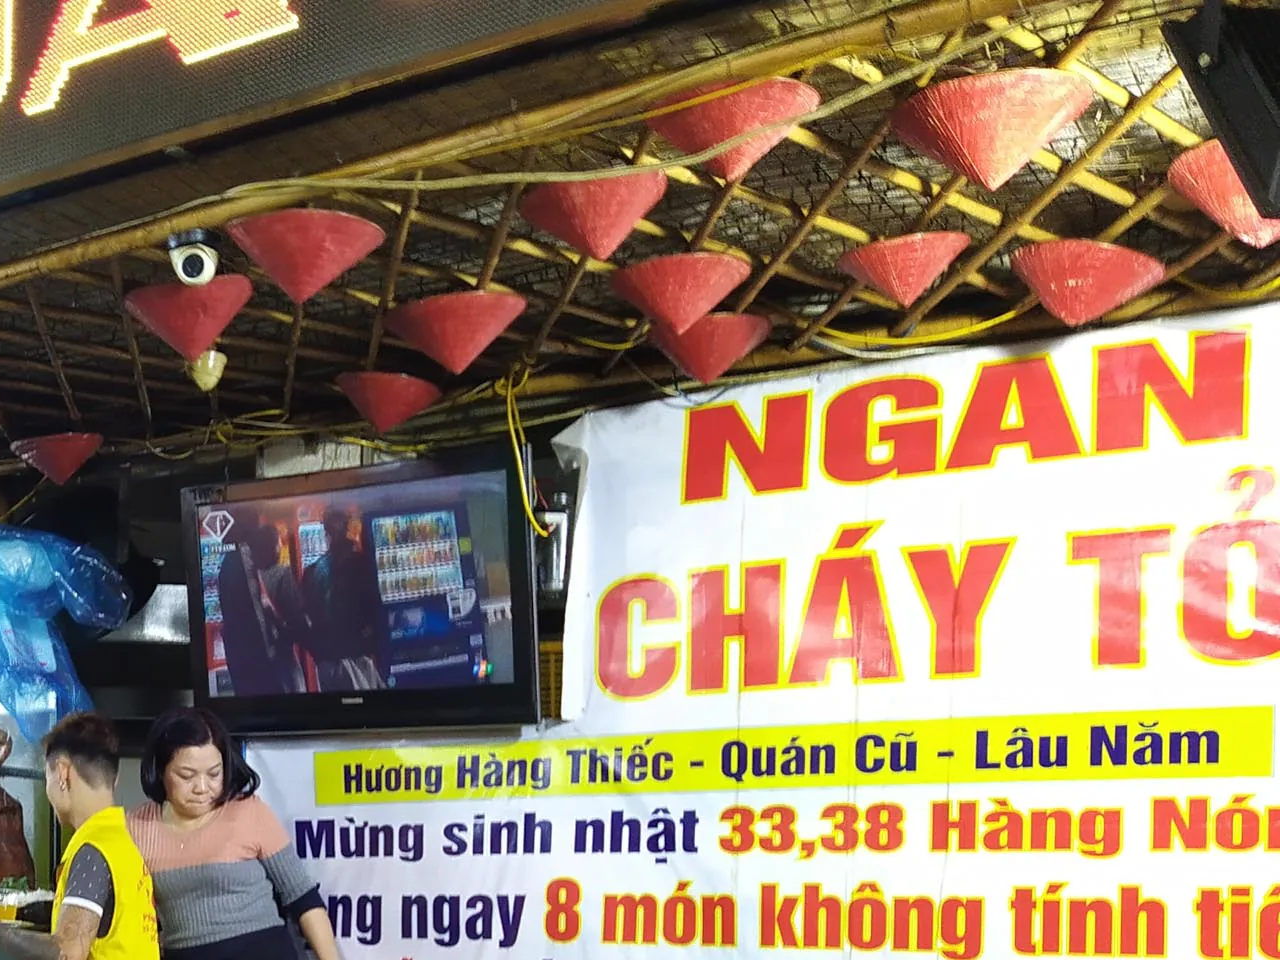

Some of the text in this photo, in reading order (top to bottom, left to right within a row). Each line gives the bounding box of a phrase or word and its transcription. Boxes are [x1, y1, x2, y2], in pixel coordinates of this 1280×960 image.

[680, 324, 1252, 505] NGAN
[594, 519, 1017, 701] CHÁY
[343, 763, 443, 794] Hương
[456, 751, 552, 790] Hàng
[567, 737, 674, 784] Thiếc
[720, 736, 836, 782] Quán
[855, 732, 918, 773] Cũ
[975, 726, 1068, 770] Lâu
[1090, 720, 1220, 767] Năm
[294, 794, 1280, 864] Mừng sinh nhật 33,38 Hàng Nó
[328, 894, 382, 946] ng
[401, 893, 526, 948] ngay
[543, 876, 582, 945] 8
[601, 879, 737, 948] món
[1009, 882, 1167, 958] tính
